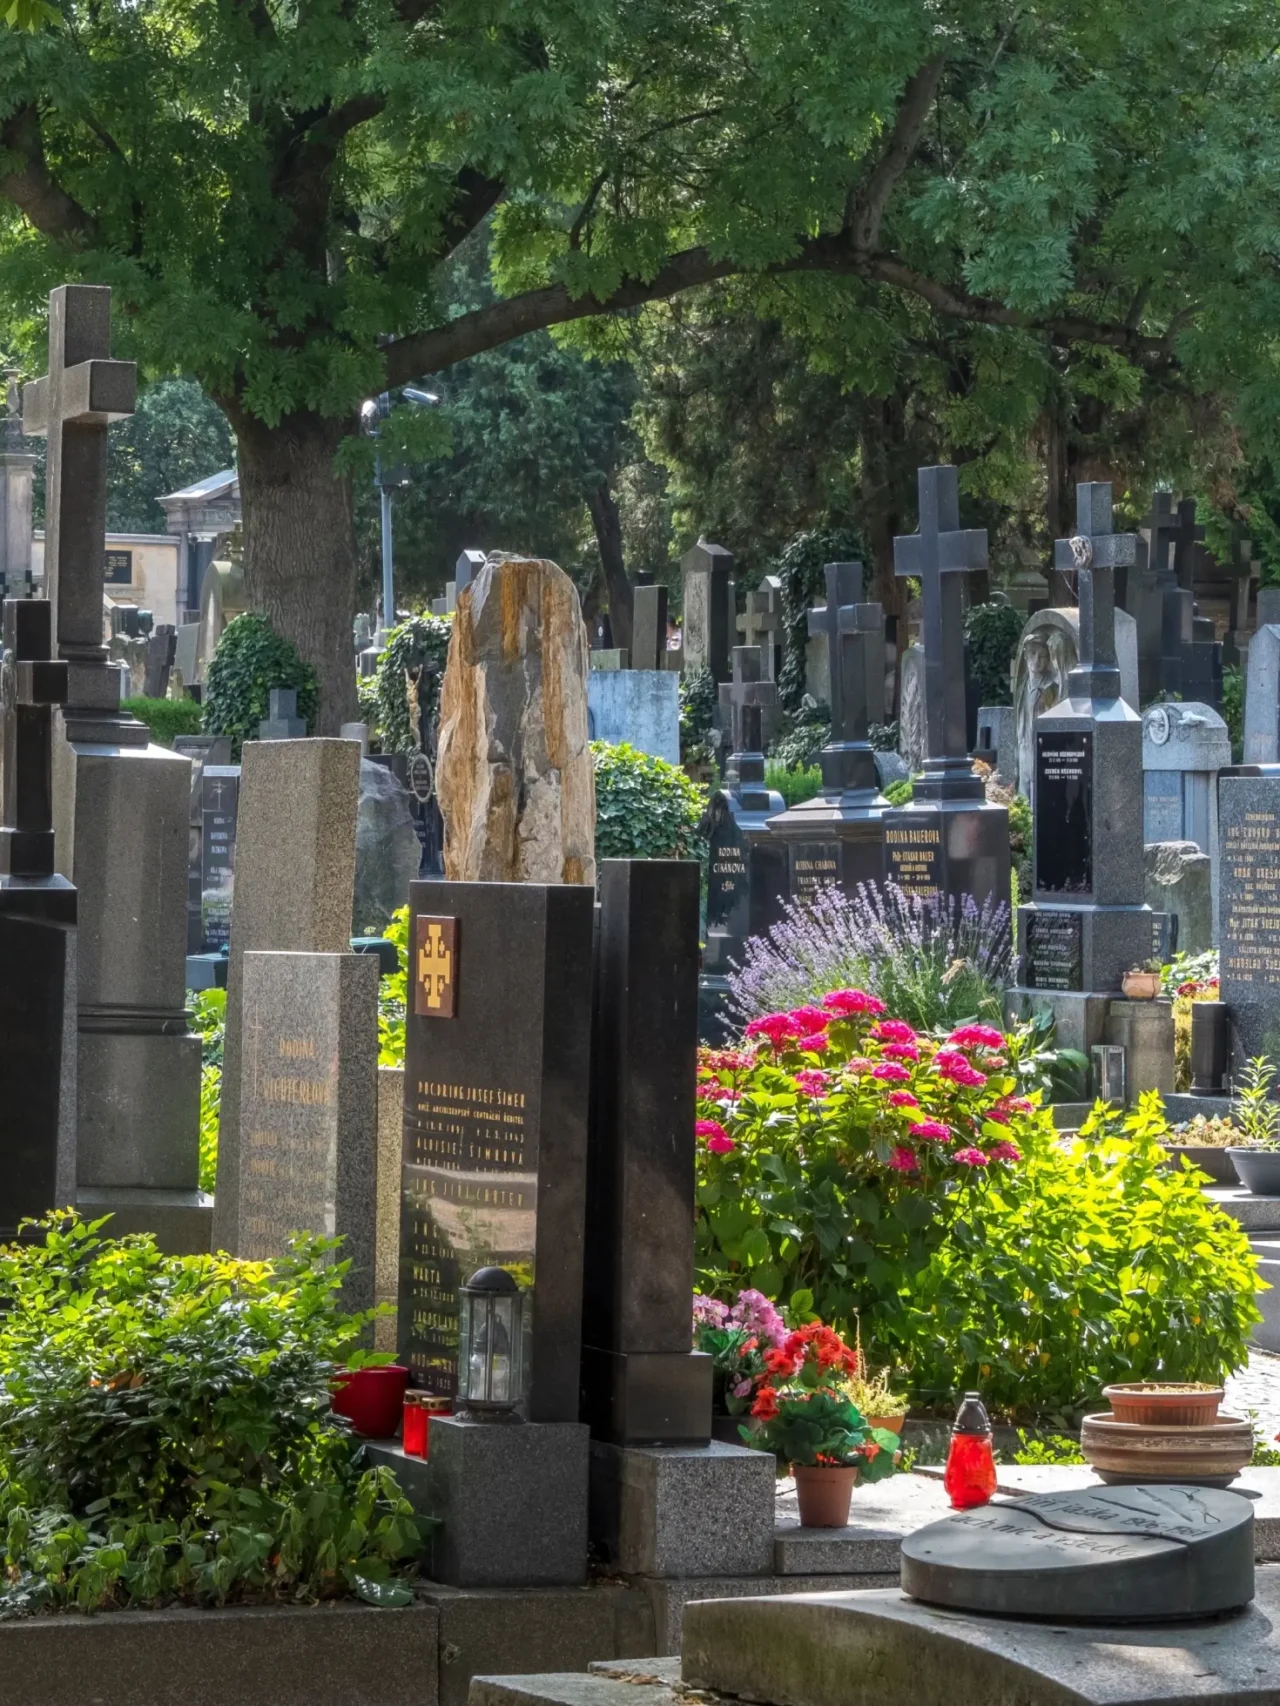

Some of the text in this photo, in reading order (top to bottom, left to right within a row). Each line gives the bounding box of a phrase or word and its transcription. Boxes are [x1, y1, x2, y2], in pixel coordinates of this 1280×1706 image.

[886, 830, 908, 844] RODINA
[718, 847, 741, 857] RODINA
[1031, 1532, 1055, 1541] a
